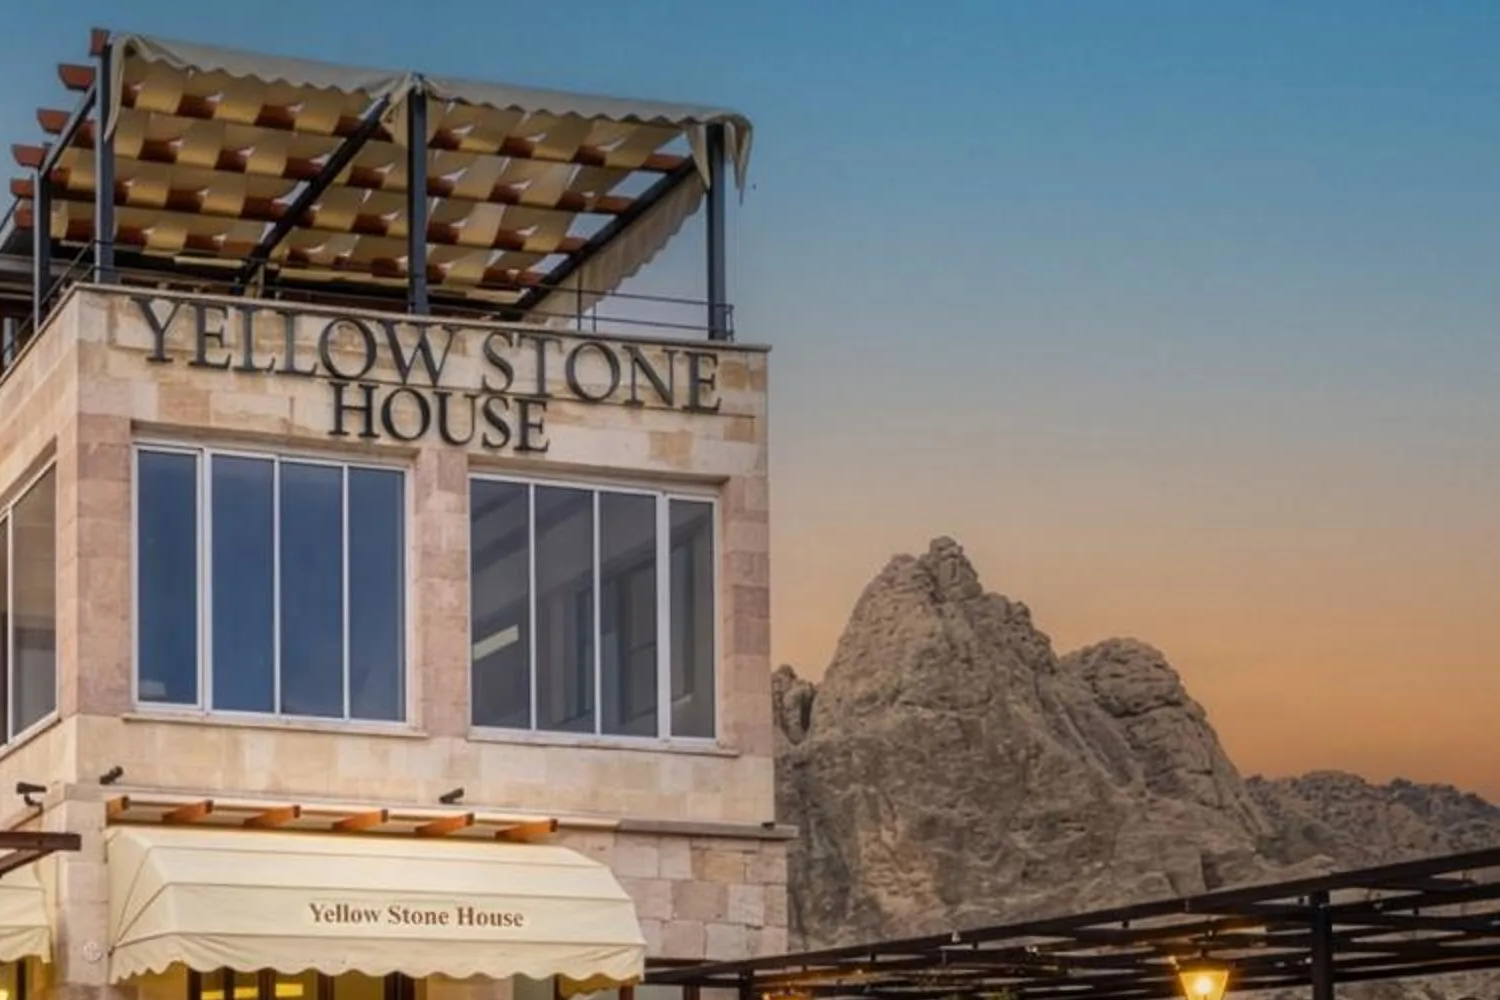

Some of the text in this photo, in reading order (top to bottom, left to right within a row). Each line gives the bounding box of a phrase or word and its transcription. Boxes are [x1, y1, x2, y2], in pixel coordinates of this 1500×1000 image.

[130, 297, 723, 414] YELLOW STONE
[328, 381, 550, 452] HOUSE
[309, 903, 524, 927] Yellow Stone House
